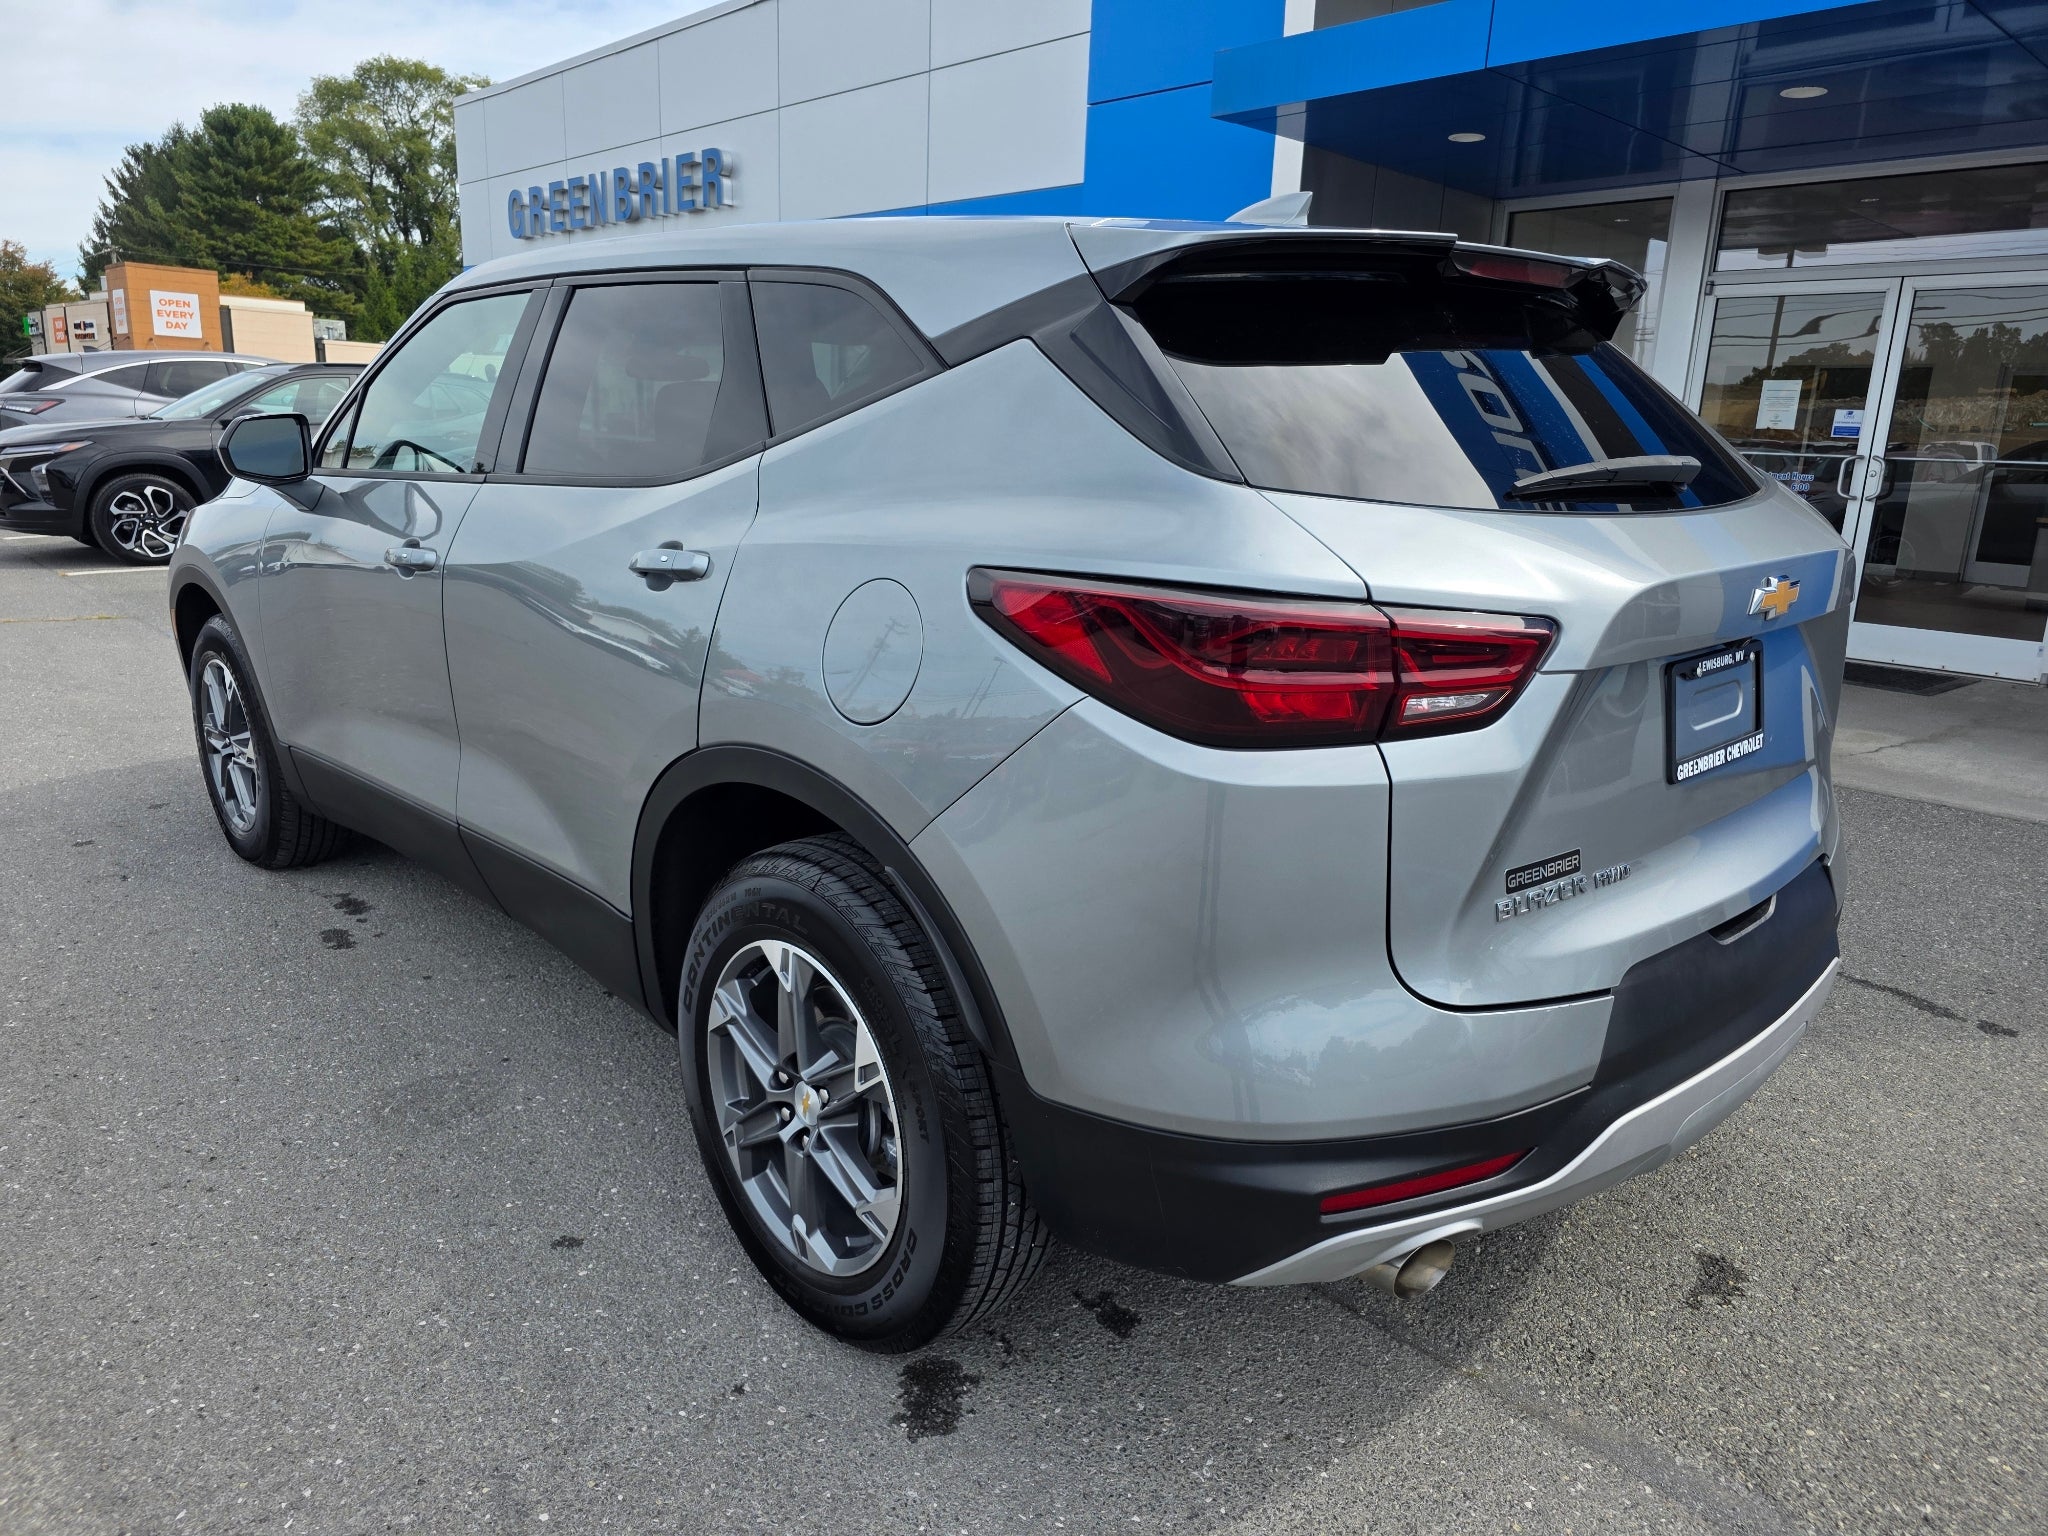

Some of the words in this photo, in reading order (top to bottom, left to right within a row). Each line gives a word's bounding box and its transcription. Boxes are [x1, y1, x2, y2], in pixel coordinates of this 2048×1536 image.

[508, 148, 729, 240] GREENBRIER
[157, 309, 194, 319] EVERY
[158, 298, 191, 308] OPEN
[166, 321, 188, 330] DAY
[1791, 483, 1810, 491] 6:00
[1792, 472, 1814, 481] Hours
[1677, 749, 1725, 781] GREENBRIER
[1726, 733, 1764, 762] CHEVROLET
[1507, 854, 1579, 888] GREENBRIER
[1495, 874, 1588, 922] BLAZER
[683, 901, 809, 1015] CONTINENTAL
